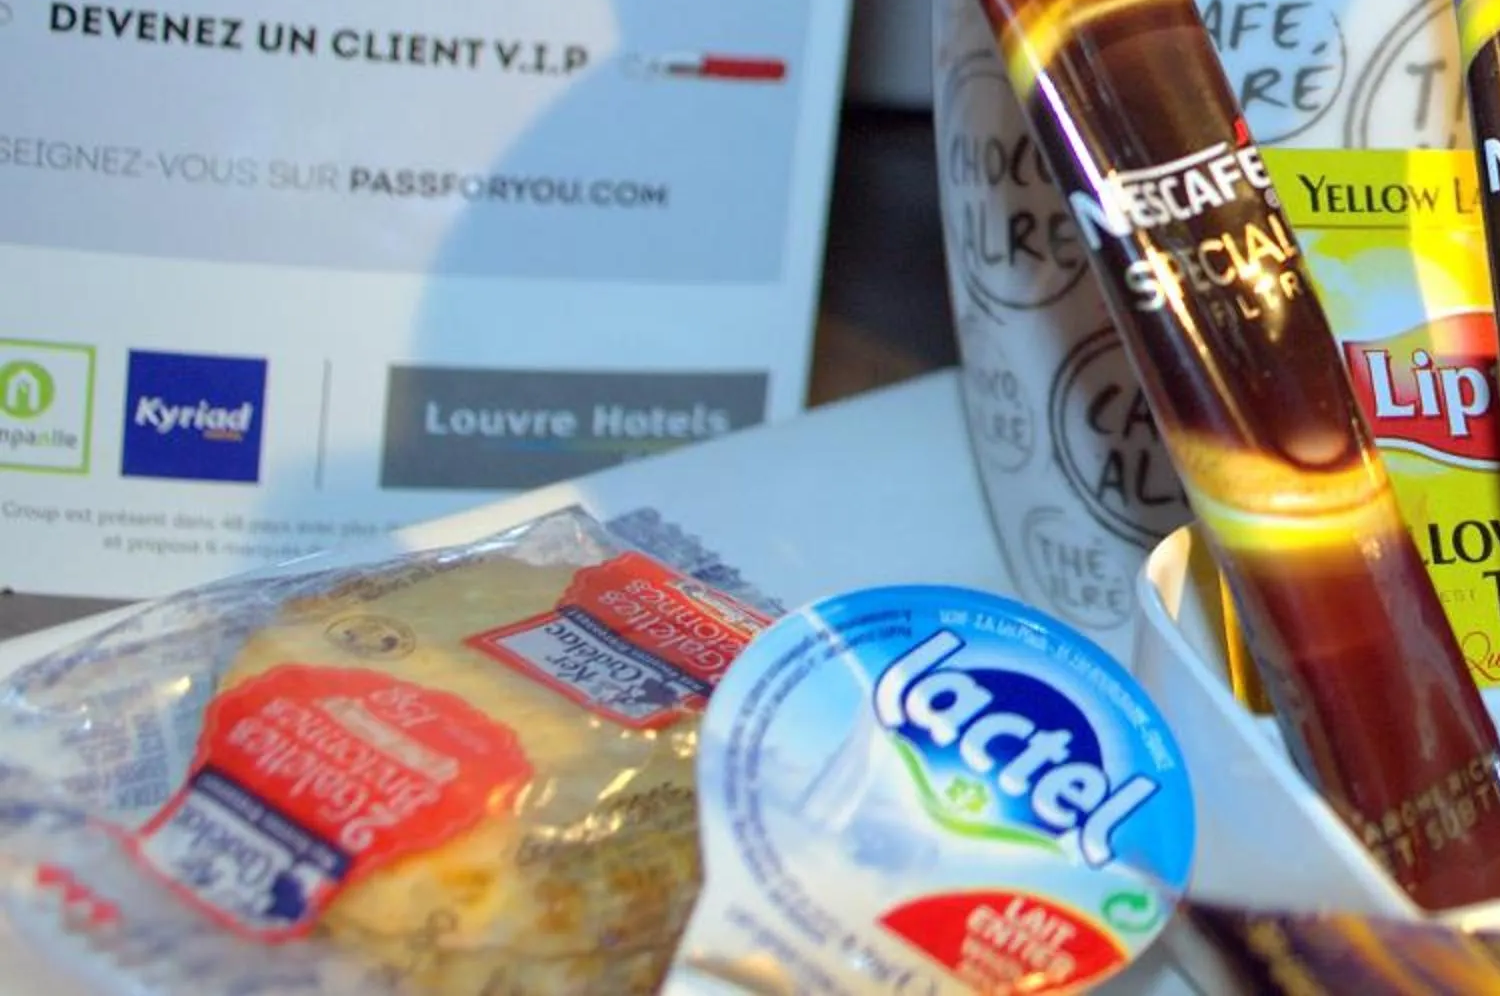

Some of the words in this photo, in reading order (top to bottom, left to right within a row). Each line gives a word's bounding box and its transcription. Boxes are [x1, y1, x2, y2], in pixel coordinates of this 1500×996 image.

[50, 1, 242, 51] DEVENEZ
[257, 23, 317, 57] UN
[332, 28, 481, 70] CLIENT
[268, 157, 341, 194] SUR
[349, 166, 670, 209] PASSFORYOU.COM
[1297, 173, 1440, 215] YELLOW
[134, 395, 254, 435] Kyriad
[425, 400, 579, 437] Louvre
[592, 402, 732, 438] Hotels
[873, 628, 1162, 869] lactel
